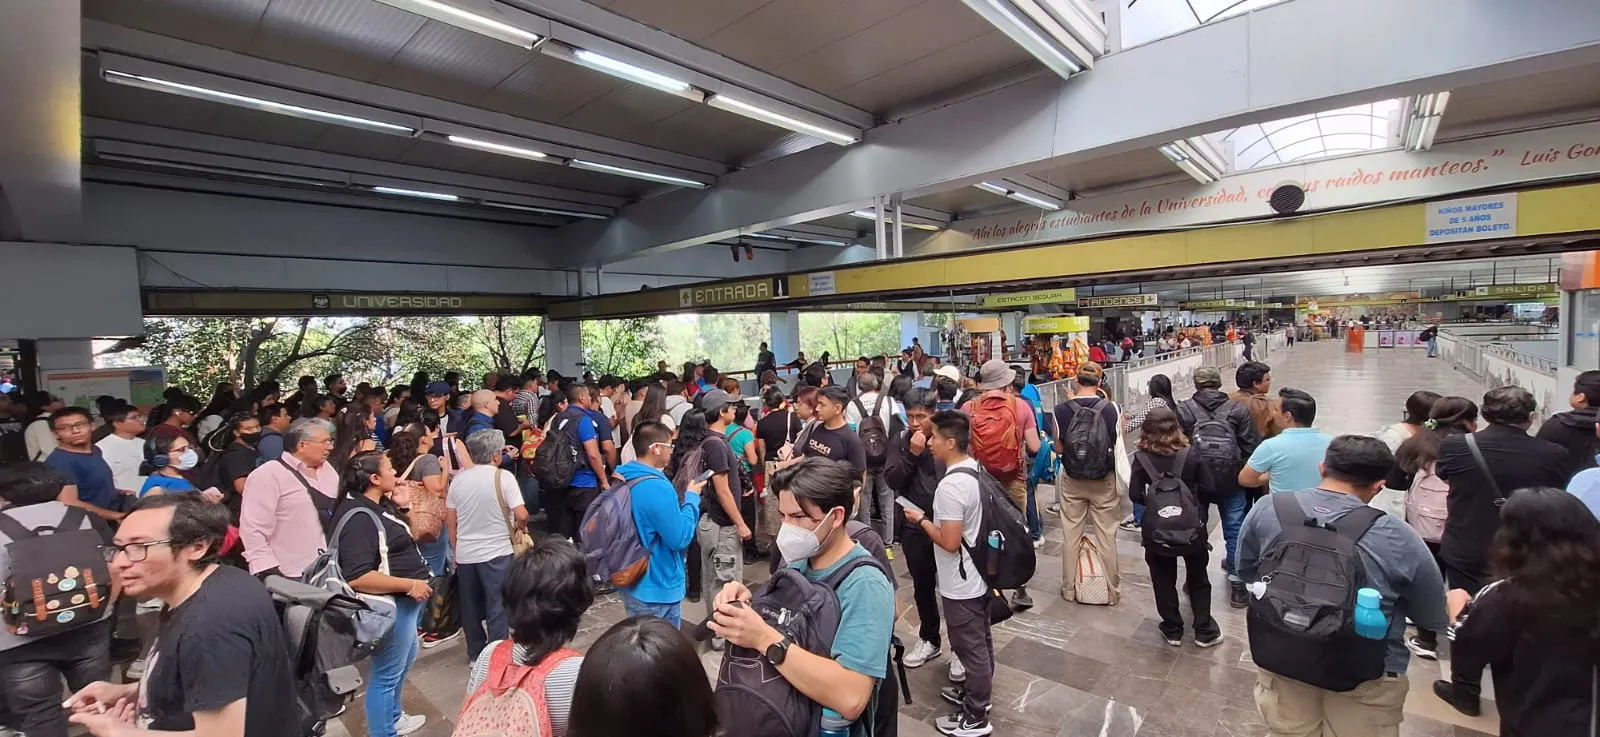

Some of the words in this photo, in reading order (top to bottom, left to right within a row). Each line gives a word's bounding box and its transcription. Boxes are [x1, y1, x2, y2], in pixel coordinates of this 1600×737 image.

[993, 223, 1006, 237] los
[1050, 211, 1118, 228] estudiantes
[1121, 204, 1135, 218] de
[1140, 200, 1152, 216] la
[1157, 185, 1247, 214] Universidad,
[1520, 149, 1560, 166] Luis
[1465, 201, 1504, 212] MAYORES
[1430, 225, 1473, 236] DEPOSITAN
[695, 282, 768, 303] ENTRADA
[1495, 284, 1546, 294] SALIDA
[343, 295, 462, 308] UNIVERSIDAD
[1091, 296, 1142, 305] ANDENES
